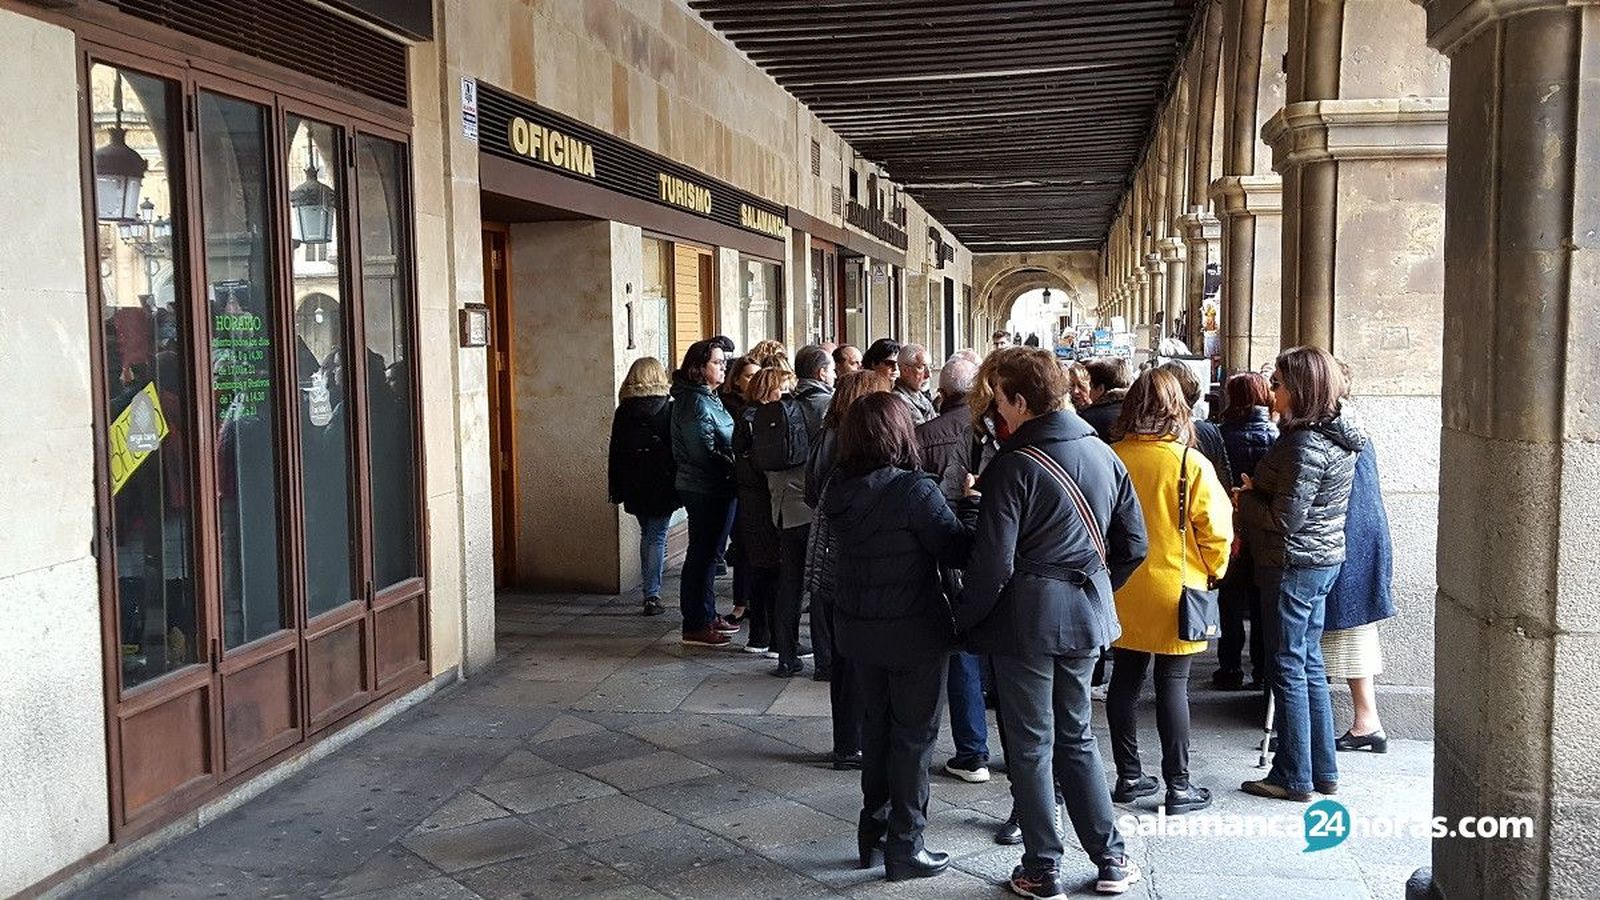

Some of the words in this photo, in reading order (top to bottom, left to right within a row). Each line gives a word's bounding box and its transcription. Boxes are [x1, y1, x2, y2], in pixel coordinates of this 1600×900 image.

[510, 116, 596, 178] OFICINA
[658, 173, 712, 214] TURISMO
[216, 315, 261, 331] HORARIO
